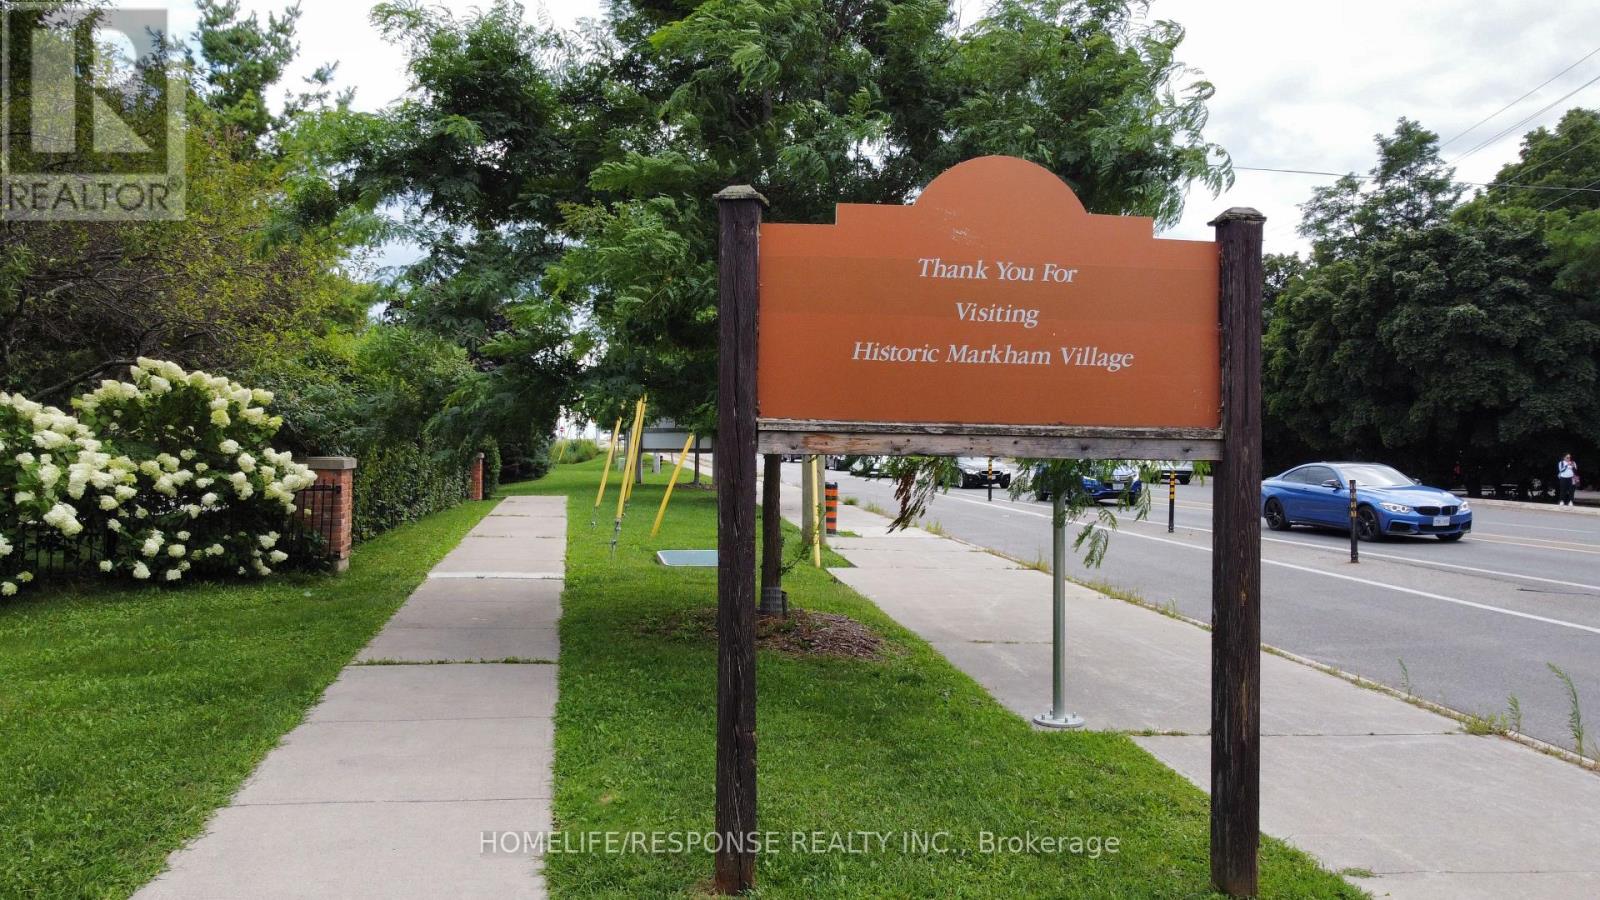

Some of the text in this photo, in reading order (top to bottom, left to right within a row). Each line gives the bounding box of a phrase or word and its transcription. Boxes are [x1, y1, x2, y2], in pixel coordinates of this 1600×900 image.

[918, 257, 1078, 284] Thank You For
[955, 302, 1040, 329] Visiting
[852, 341, 1135, 372] Historic Markham Village
